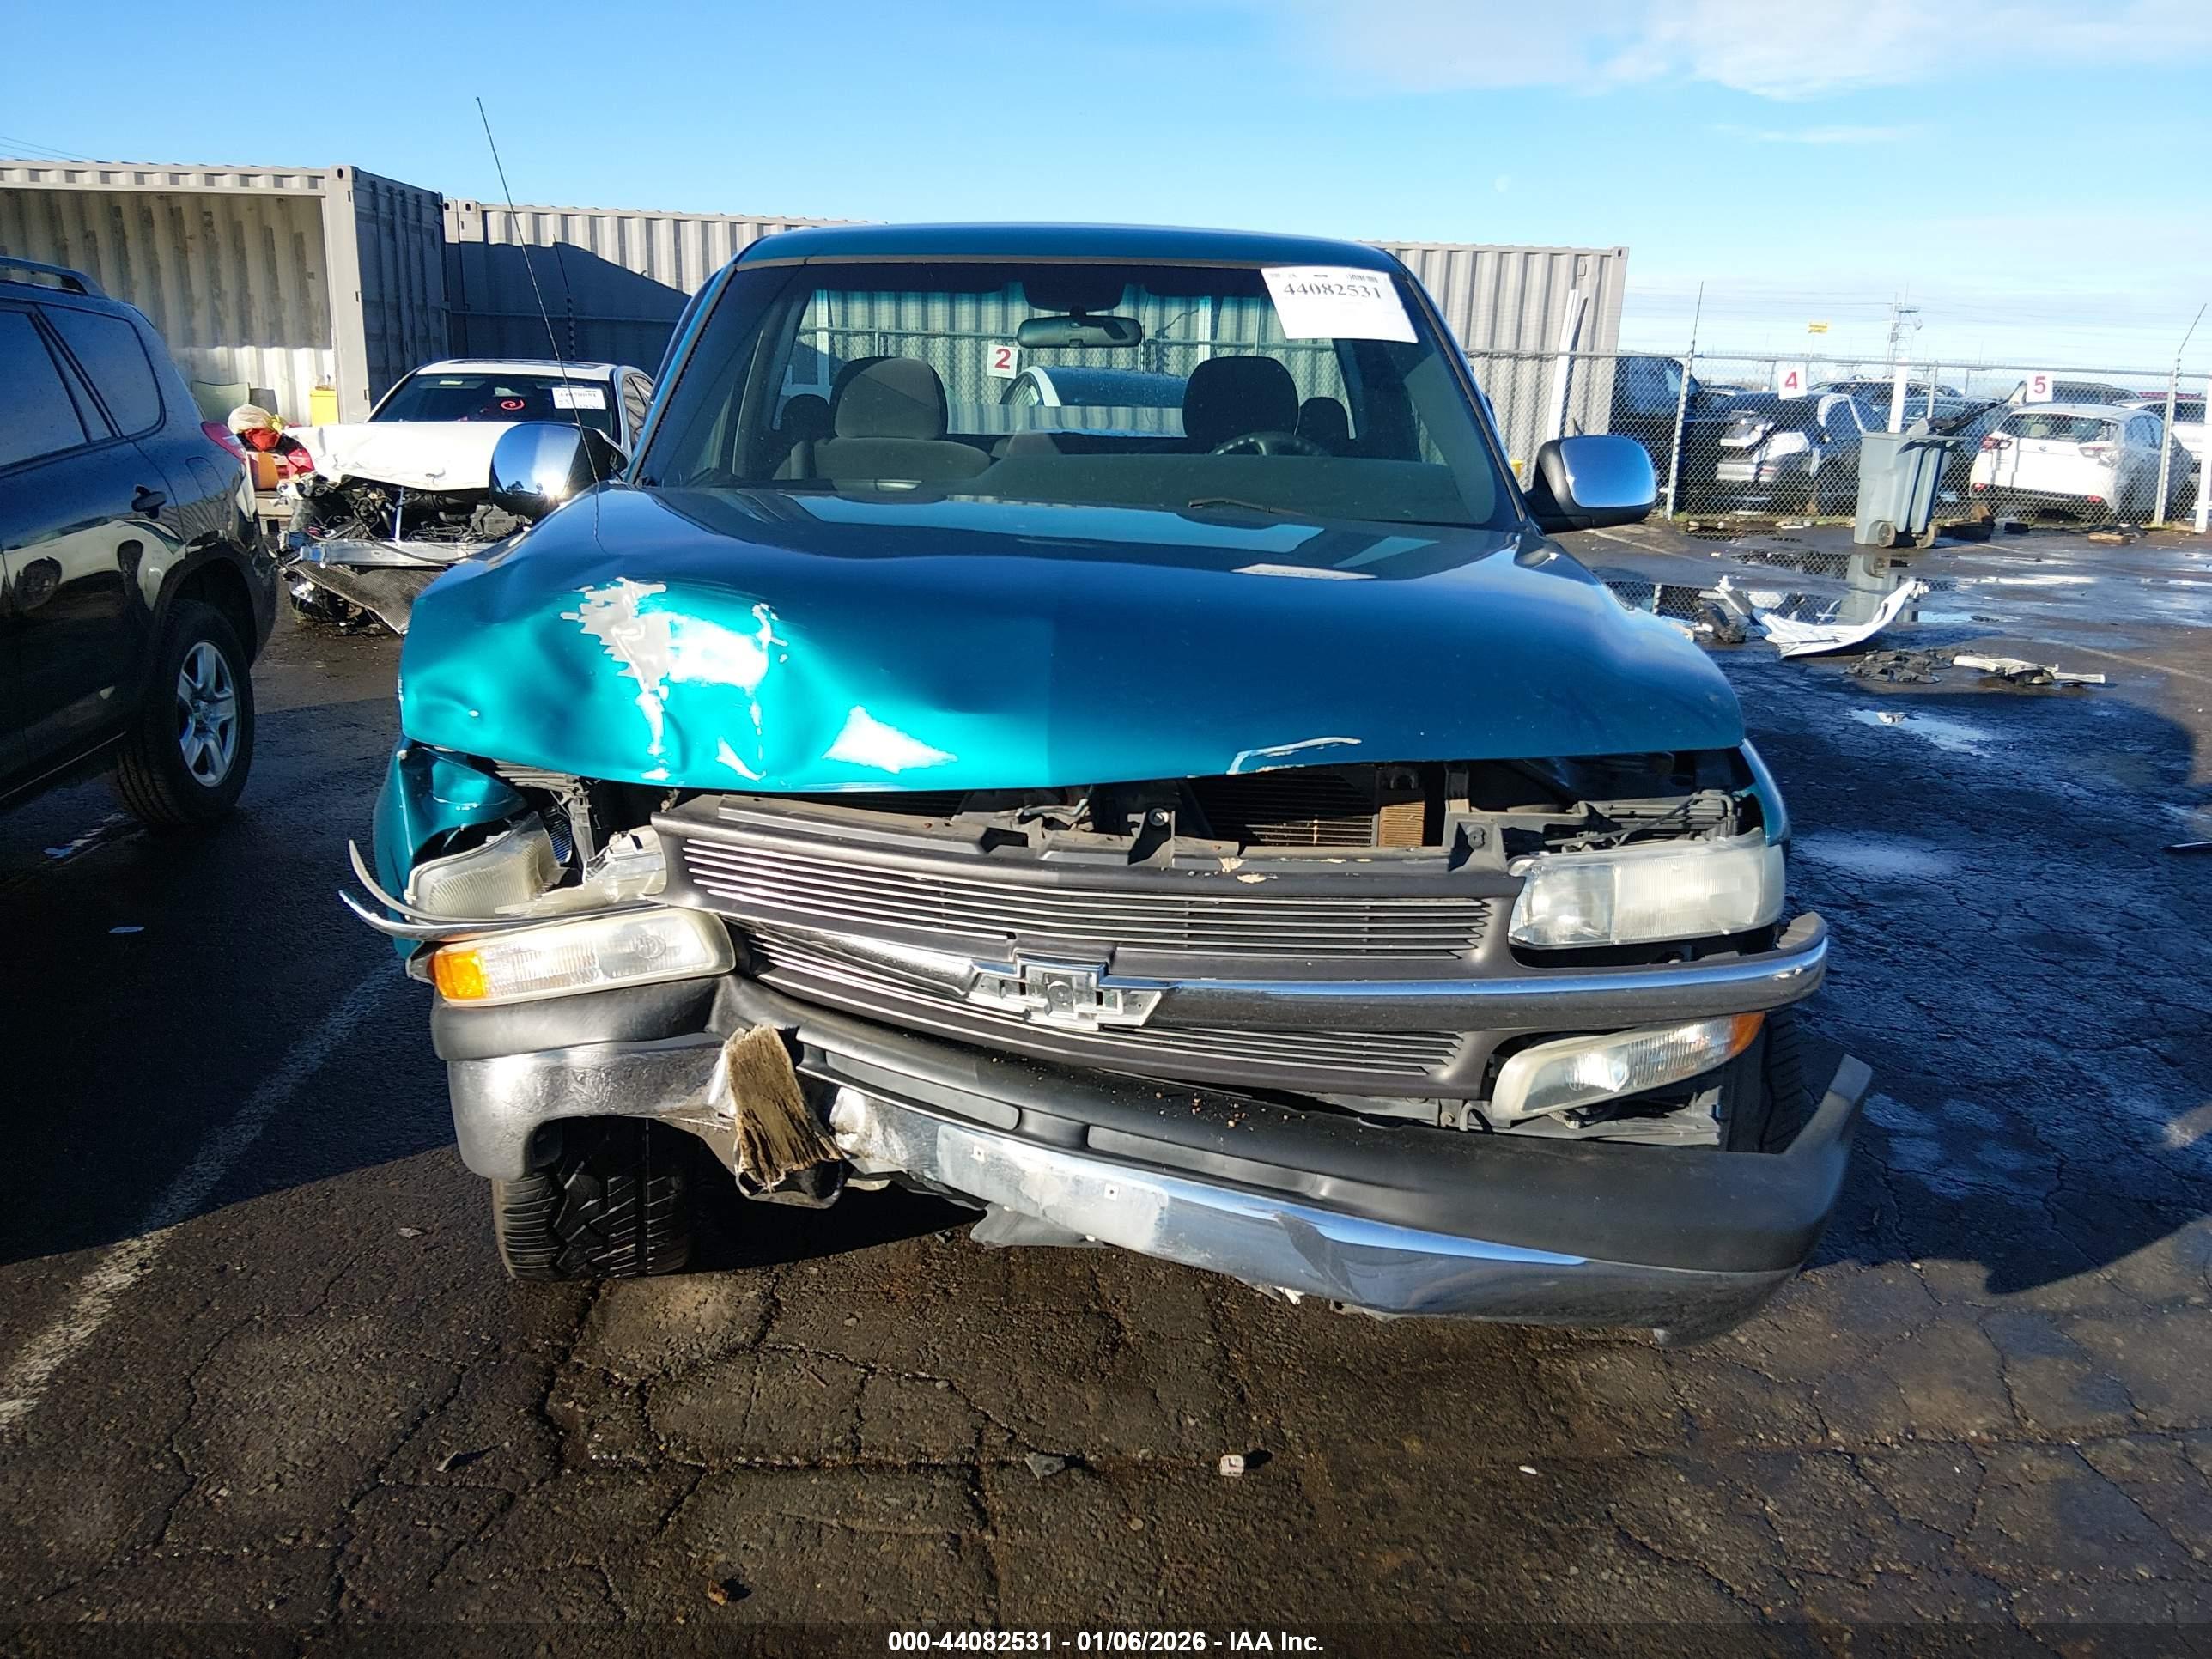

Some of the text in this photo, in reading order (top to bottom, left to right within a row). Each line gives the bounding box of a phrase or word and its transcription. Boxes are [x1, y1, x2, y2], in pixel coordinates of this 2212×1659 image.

[1283, 283, 1382, 299] 44082531
[994, 348, 1012, 370] 2
[1784, 371, 1798, 390] 4
[2033, 375, 2046, 394] 5
